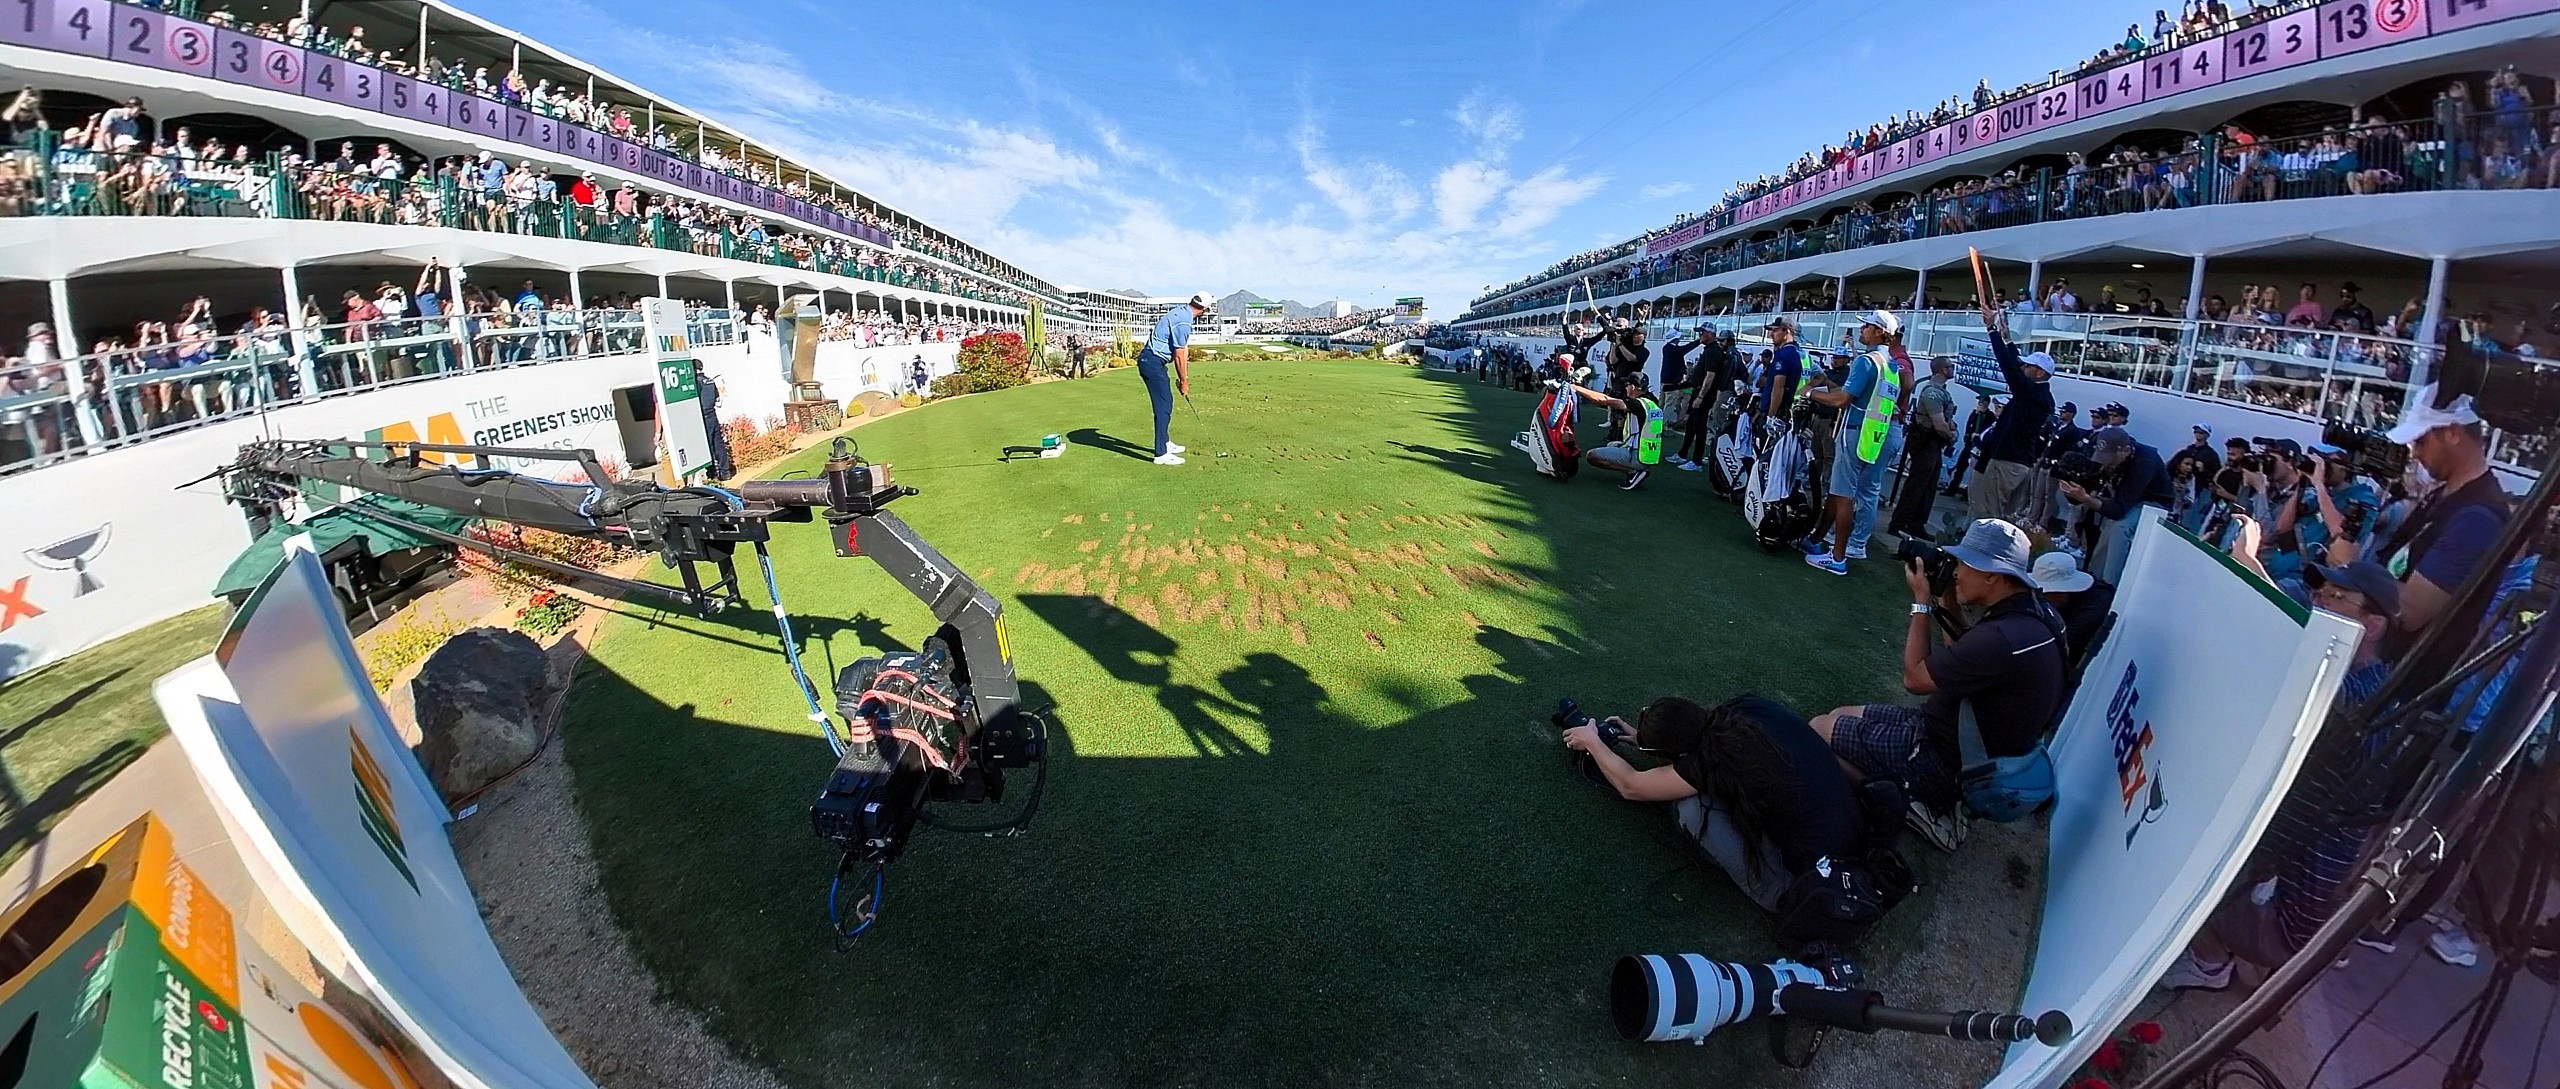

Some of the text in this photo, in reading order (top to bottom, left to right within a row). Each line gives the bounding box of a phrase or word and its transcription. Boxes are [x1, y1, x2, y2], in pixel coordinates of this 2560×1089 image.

[68, 7, 92, 41] 4
[129, 17, 151, 54] 2
[181, 31, 199, 61] 3
[230, 41, 249, 74] 3
[271, 54, 290, 81] 4
[317, 63, 335, 93] 4
[357, 74, 371, 99] 3
[393, 82, 407, 110] 5
[424, 91, 437, 116] 4
[459, 97, 473, 124] 6
[486, 107, 499, 130] 4
[515, 114, 528, 138] 7
[541, 124, 552, 144] 3
[566, 129, 576, 151] 8
[587, 136, 596, 155] 4
[610, 142, 618, 161] 9
[629, 150, 637, 166] 3
[643, 152, 667, 177] OUT
[668, 162, 684, 182] 32
[690, 169, 700, 187] 10
[705, 175, 712, 189] 4
[718, 178, 729, 195] 11
[732, 183, 738, 197] 4
[744, 186, 754, 202] 12
[756, 191, 762, 203] 3
[766, 194, 775, 209] 13
[1649, 235, 1670, 253] SCOTTIE
[1669, 225, 1701, 248] SCHEFFLER
[1705, 219, 1717, 232] -18
[1745, 205, 1750, 217] 4
[1754, 203, 1760, 214] 2
[1775, 196, 1780, 208] 3
[1807, 182, 1813, 195] 3
[1819, 177, 1826, 191] 5
[1831, 173, 1838, 185] 4
[1862, 160, 1869, 174] 4
[1879, 152, 1887, 170] 7
[1897, 147, 1904, 165] 3
[1916, 139, 1924, 158] 8
[1935, 133, 1944, 151] 4
[1958, 125, 1968, 146] 9
[1981, 118, 1991, 138] 3
[2000, 102, 2037, 134] OUT
[2041, 92, 2068, 121] 32
[2082, 78, 2107, 108] 10
[2117, 72, 2132, 97] 4
[2152, 57, 2180, 89] 11
[2193, 50, 2209, 76] 4
[2234, 31, 2267, 68] 12
[2285, 24, 2302, 54] 3
[2329, 7, 2367, 43] 13
[658, 333, 687, 352] WM
[1960, 354, 2000, 370] SCHEFFLE
[661, 366, 680, 390] 16
[465, 395, 508, 420] THE
[474, 403, 614, 447] GREENEST SHOW
[1531, 421, 1550, 465] TaylorMade
[1718, 446, 1745, 488] Titleit
[162, 973, 193, 1089] RECYCLE
